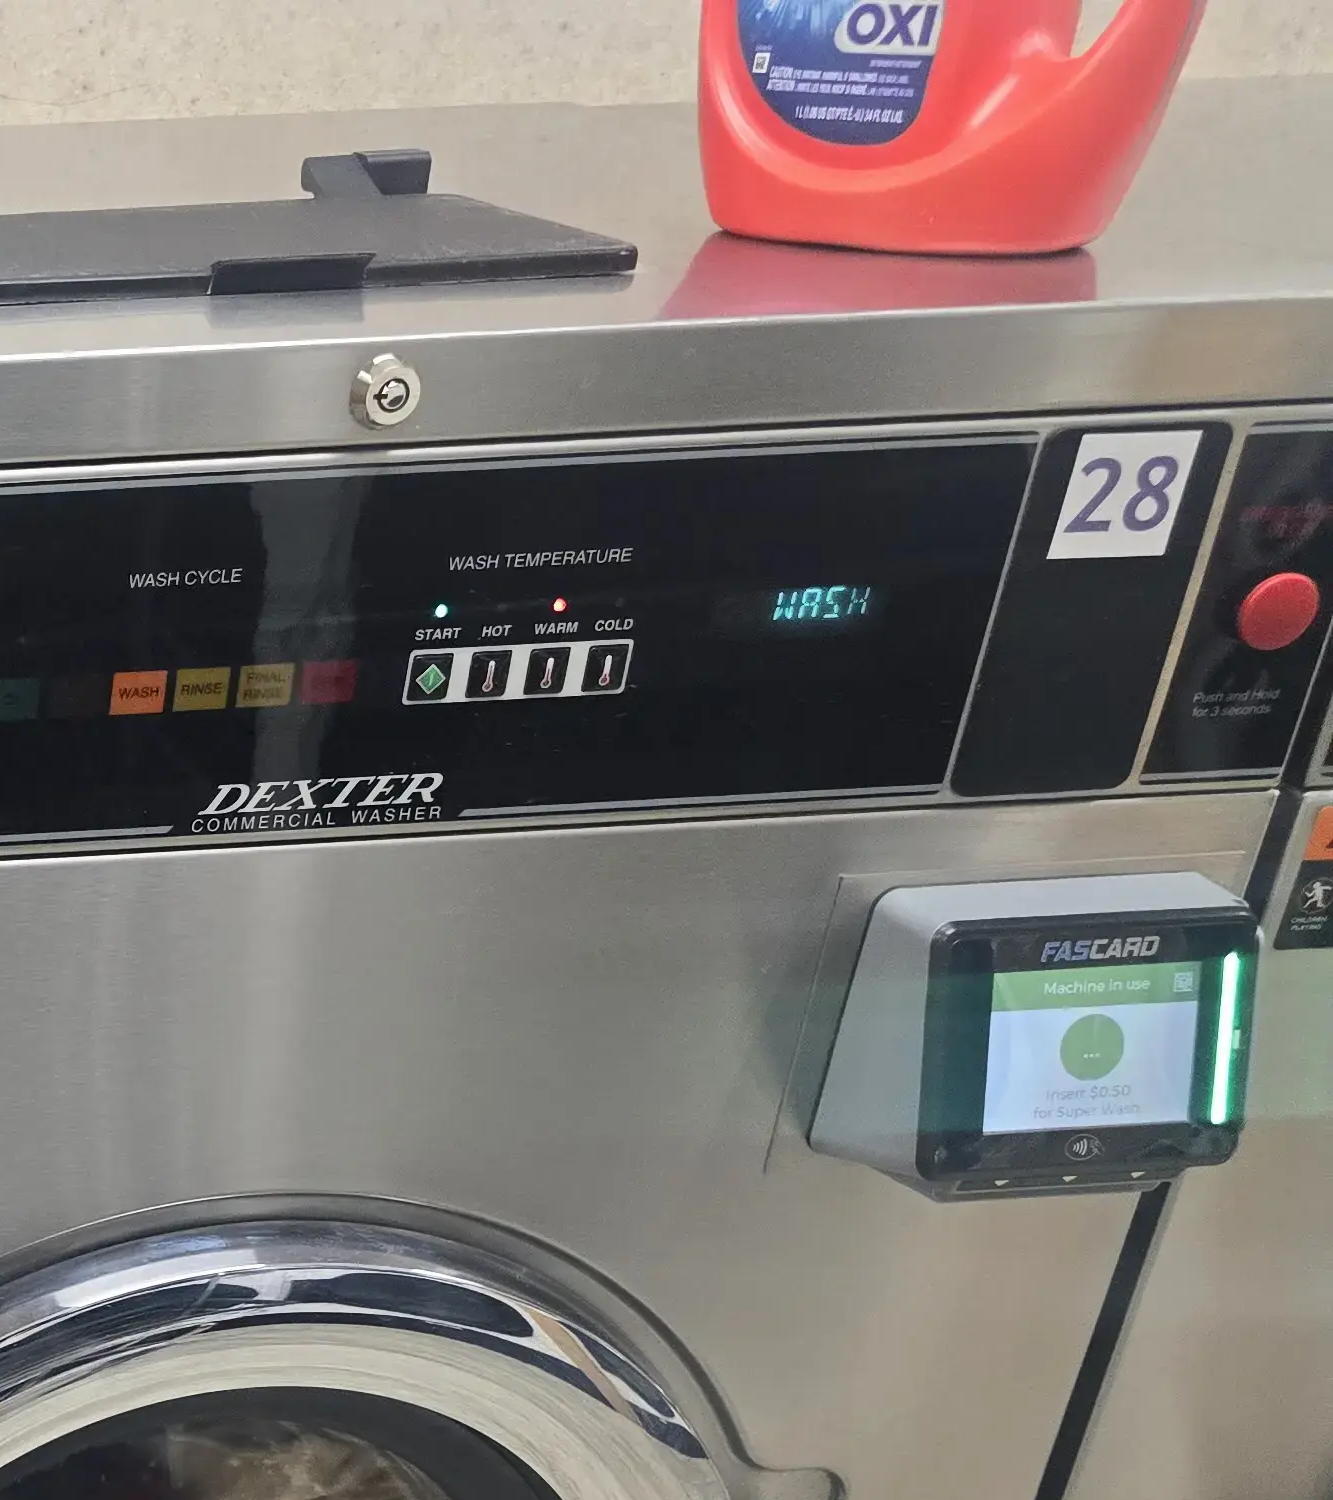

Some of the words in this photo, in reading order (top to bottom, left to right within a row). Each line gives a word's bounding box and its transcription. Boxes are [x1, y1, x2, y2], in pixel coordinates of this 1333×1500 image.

[846, 3, 938, 47] OXI
[1063, 455, 1179, 534] 28
[447, 553, 499, 572] WASH
[505, 547, 634, 569] TEMPERATURE
[129, 571, 179, 589] WASH
[184, 568, 243, 587] CYCLE
[771, 585, 871, 622] WASH
[414, 627, 461, 641] START
[480, 624, 513, 638] HOT
[533, 620, 579, 635] WARM
[593, 616, 634, 633] COLD
[118, 685, 160, 699] WASH
[180, 681, 223, 696] RINSE
[198, 772, 446, 815] DEXTER
[190, 811, 336, 833] COMMERCIAL
[350, 804, 442, 825] WASHER
[1040, 935, 1160, 963] FASCARD
[1043, 979, 1105, 995] Machine
[1109, 978, 1123, 992] in
[1125, 977, 1151, 992] use
